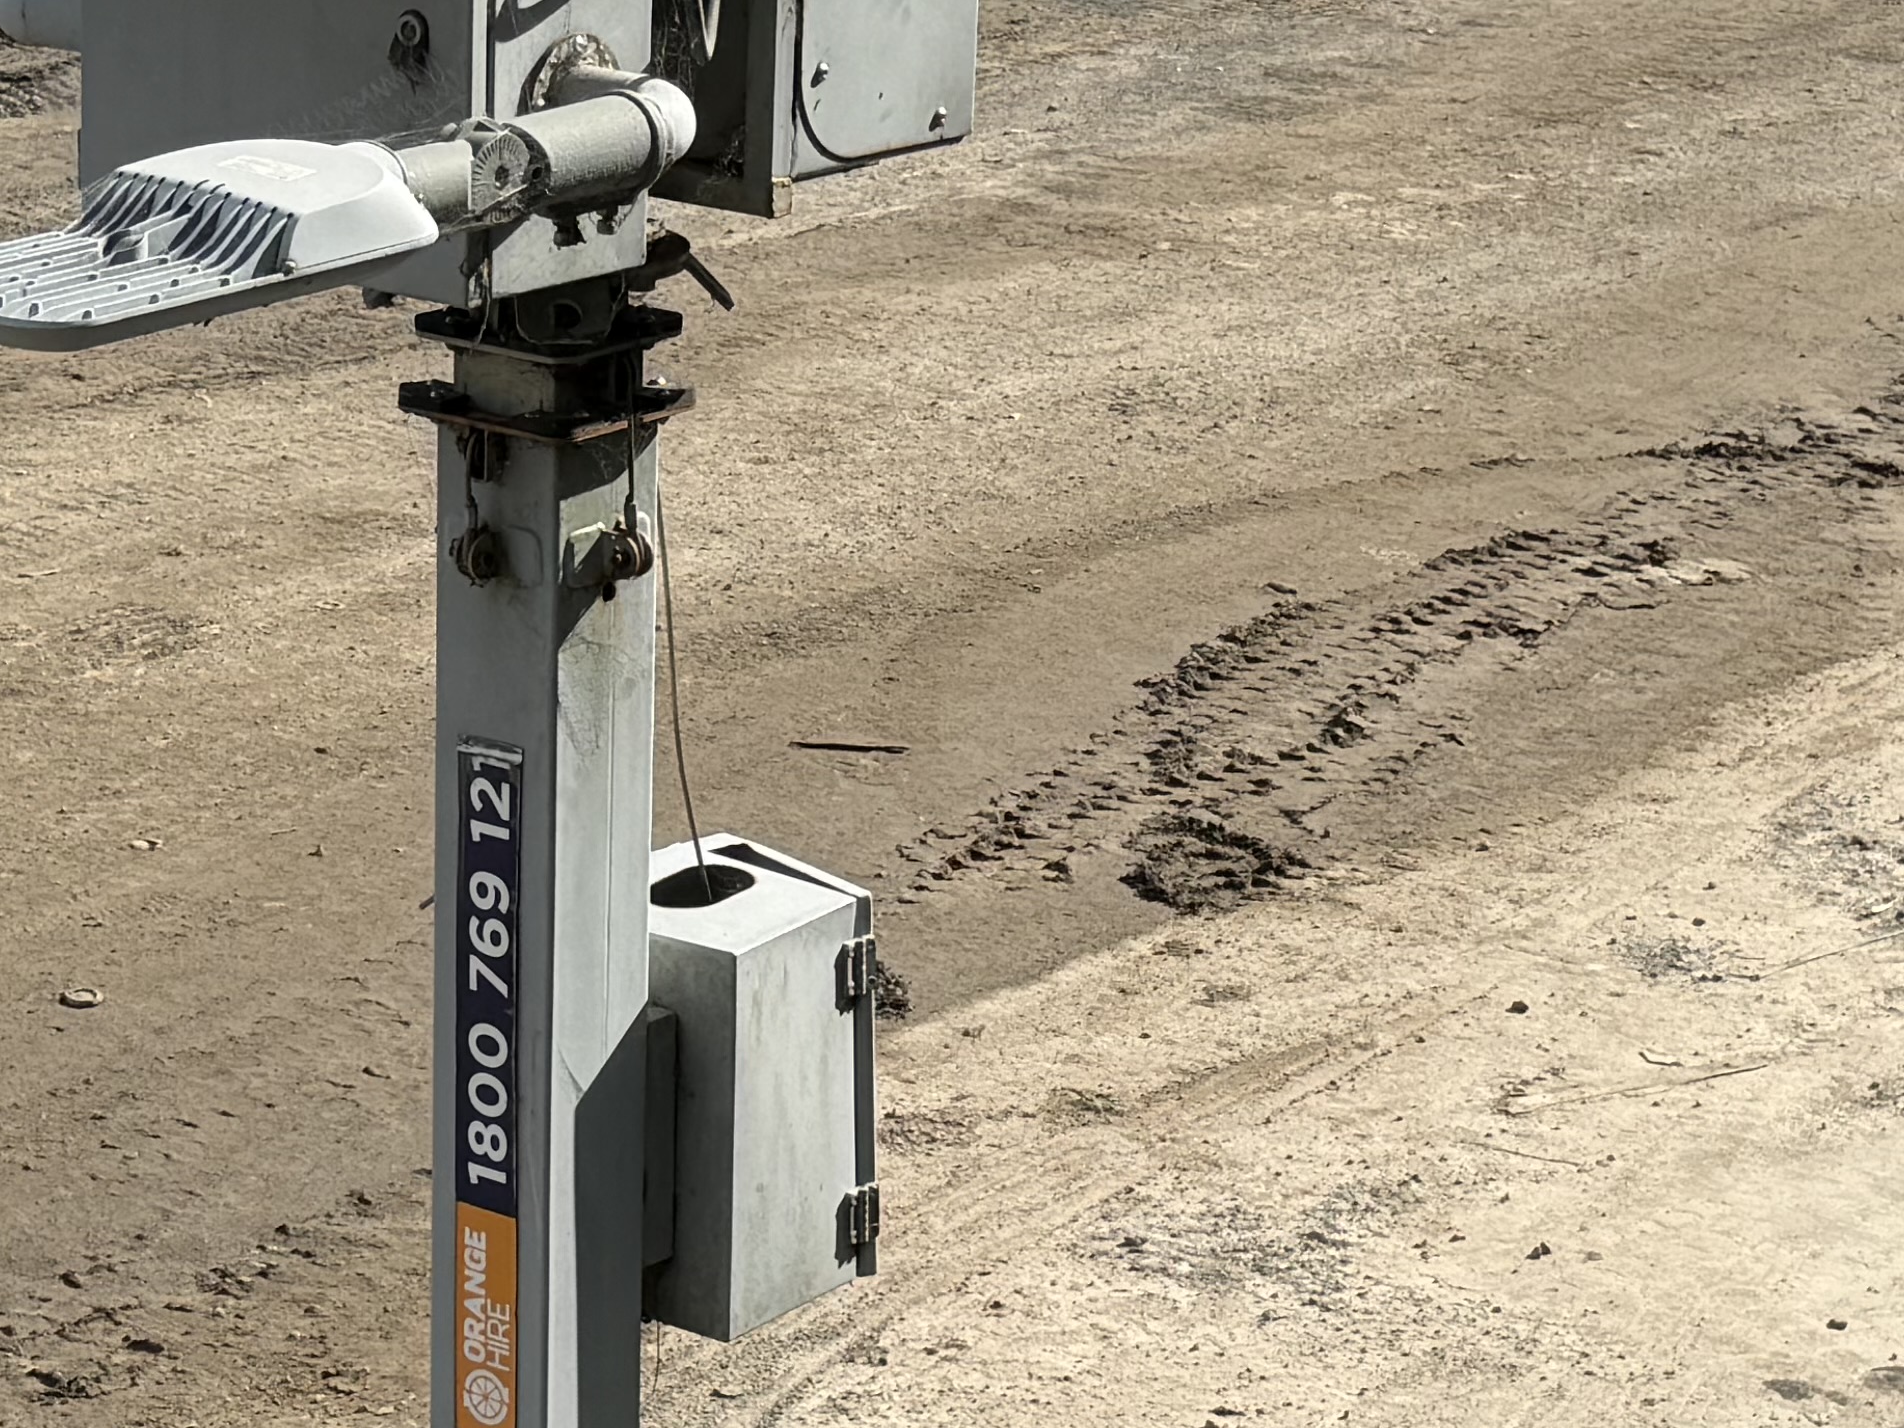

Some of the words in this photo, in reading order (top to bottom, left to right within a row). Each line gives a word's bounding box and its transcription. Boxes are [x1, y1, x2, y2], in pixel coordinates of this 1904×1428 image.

[468, 870, 510, 999] 769
[467, 1022, 509, 1185] 1800
[463, 1226, 487, 1364] ORANGE
[486, 1298, 510, 1372] HIRE
